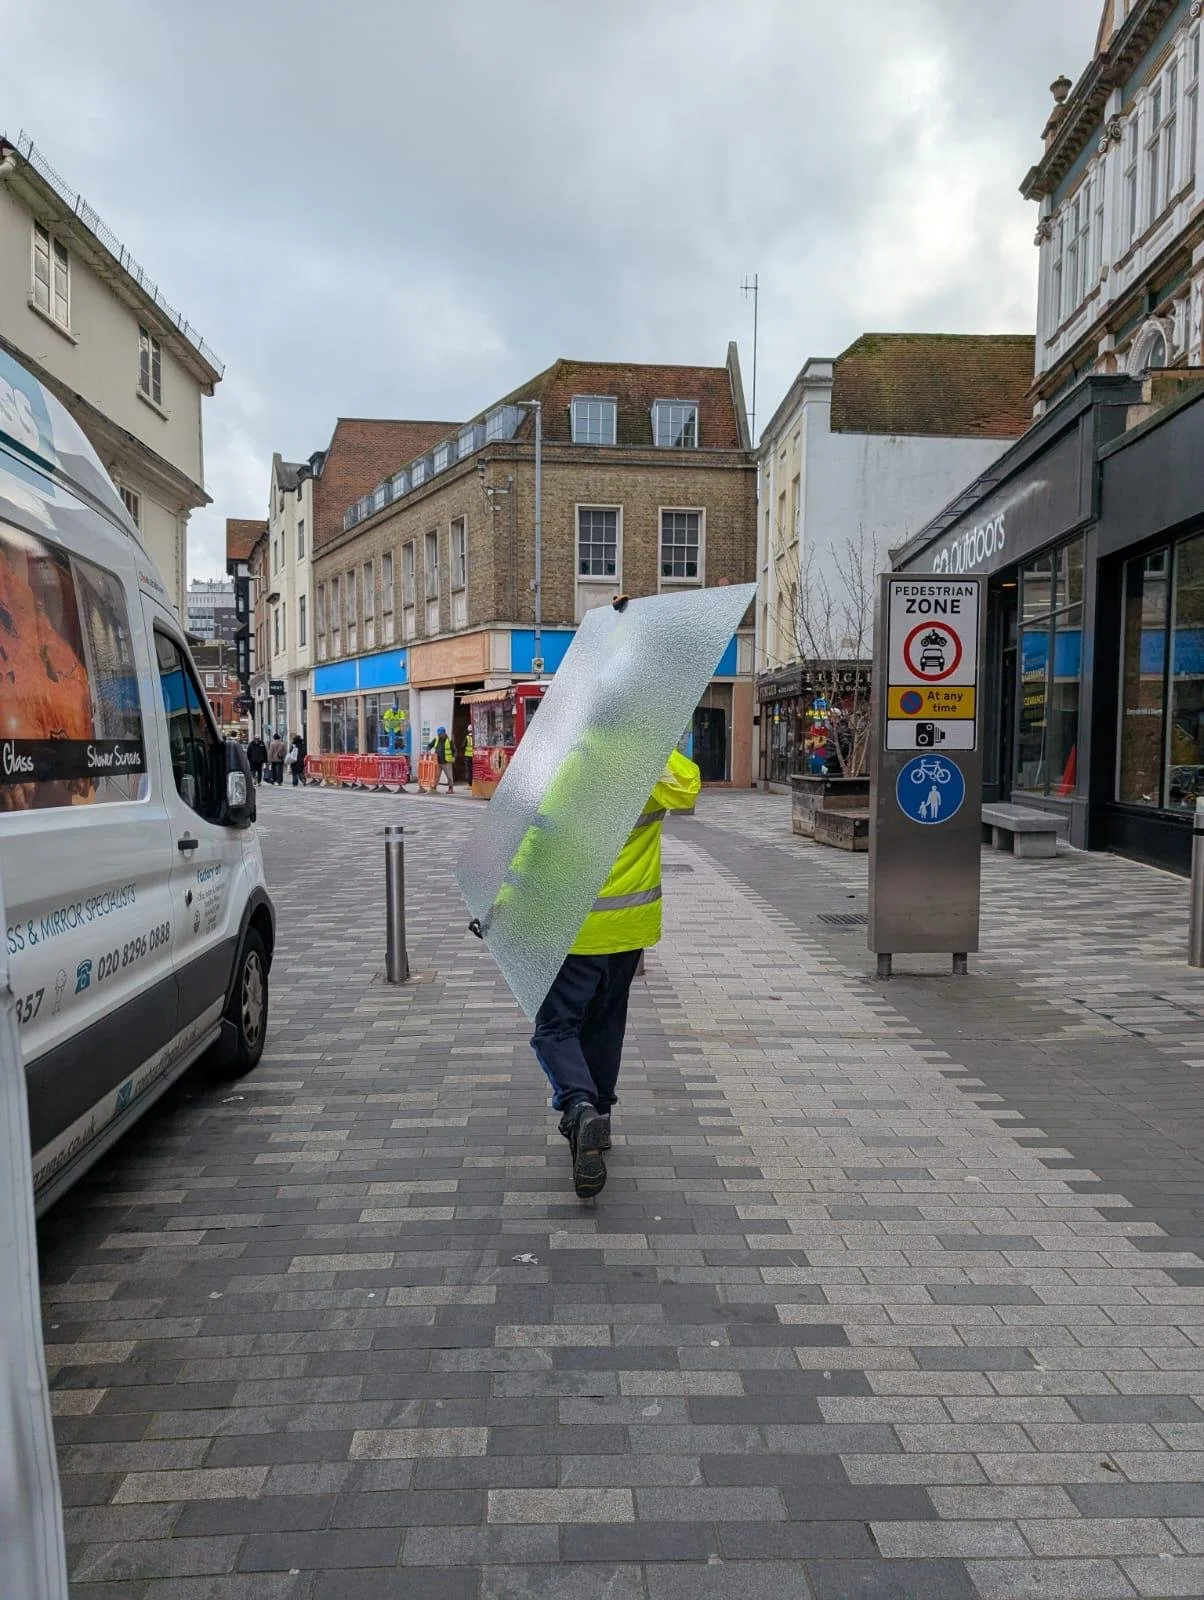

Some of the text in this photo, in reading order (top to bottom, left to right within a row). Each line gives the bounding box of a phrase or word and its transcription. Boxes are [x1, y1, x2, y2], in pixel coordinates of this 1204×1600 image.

[895, 586, 973, 597] PEDESTRIAN
[905, 598, 961, 614] ZONE
[927, 691, 964, 703] At any
[933, 703, 957, 713] time
[3, 739, 34, 775] Glass
[87, 745, 113, 768] Shower
[7, 883, 136, 955] SS & MIRROR SPECIALISTS
[98, 949, 120, 982] 020
[122, 935, 147, 969] 8296
[149, 921, 171, 952] 0888
